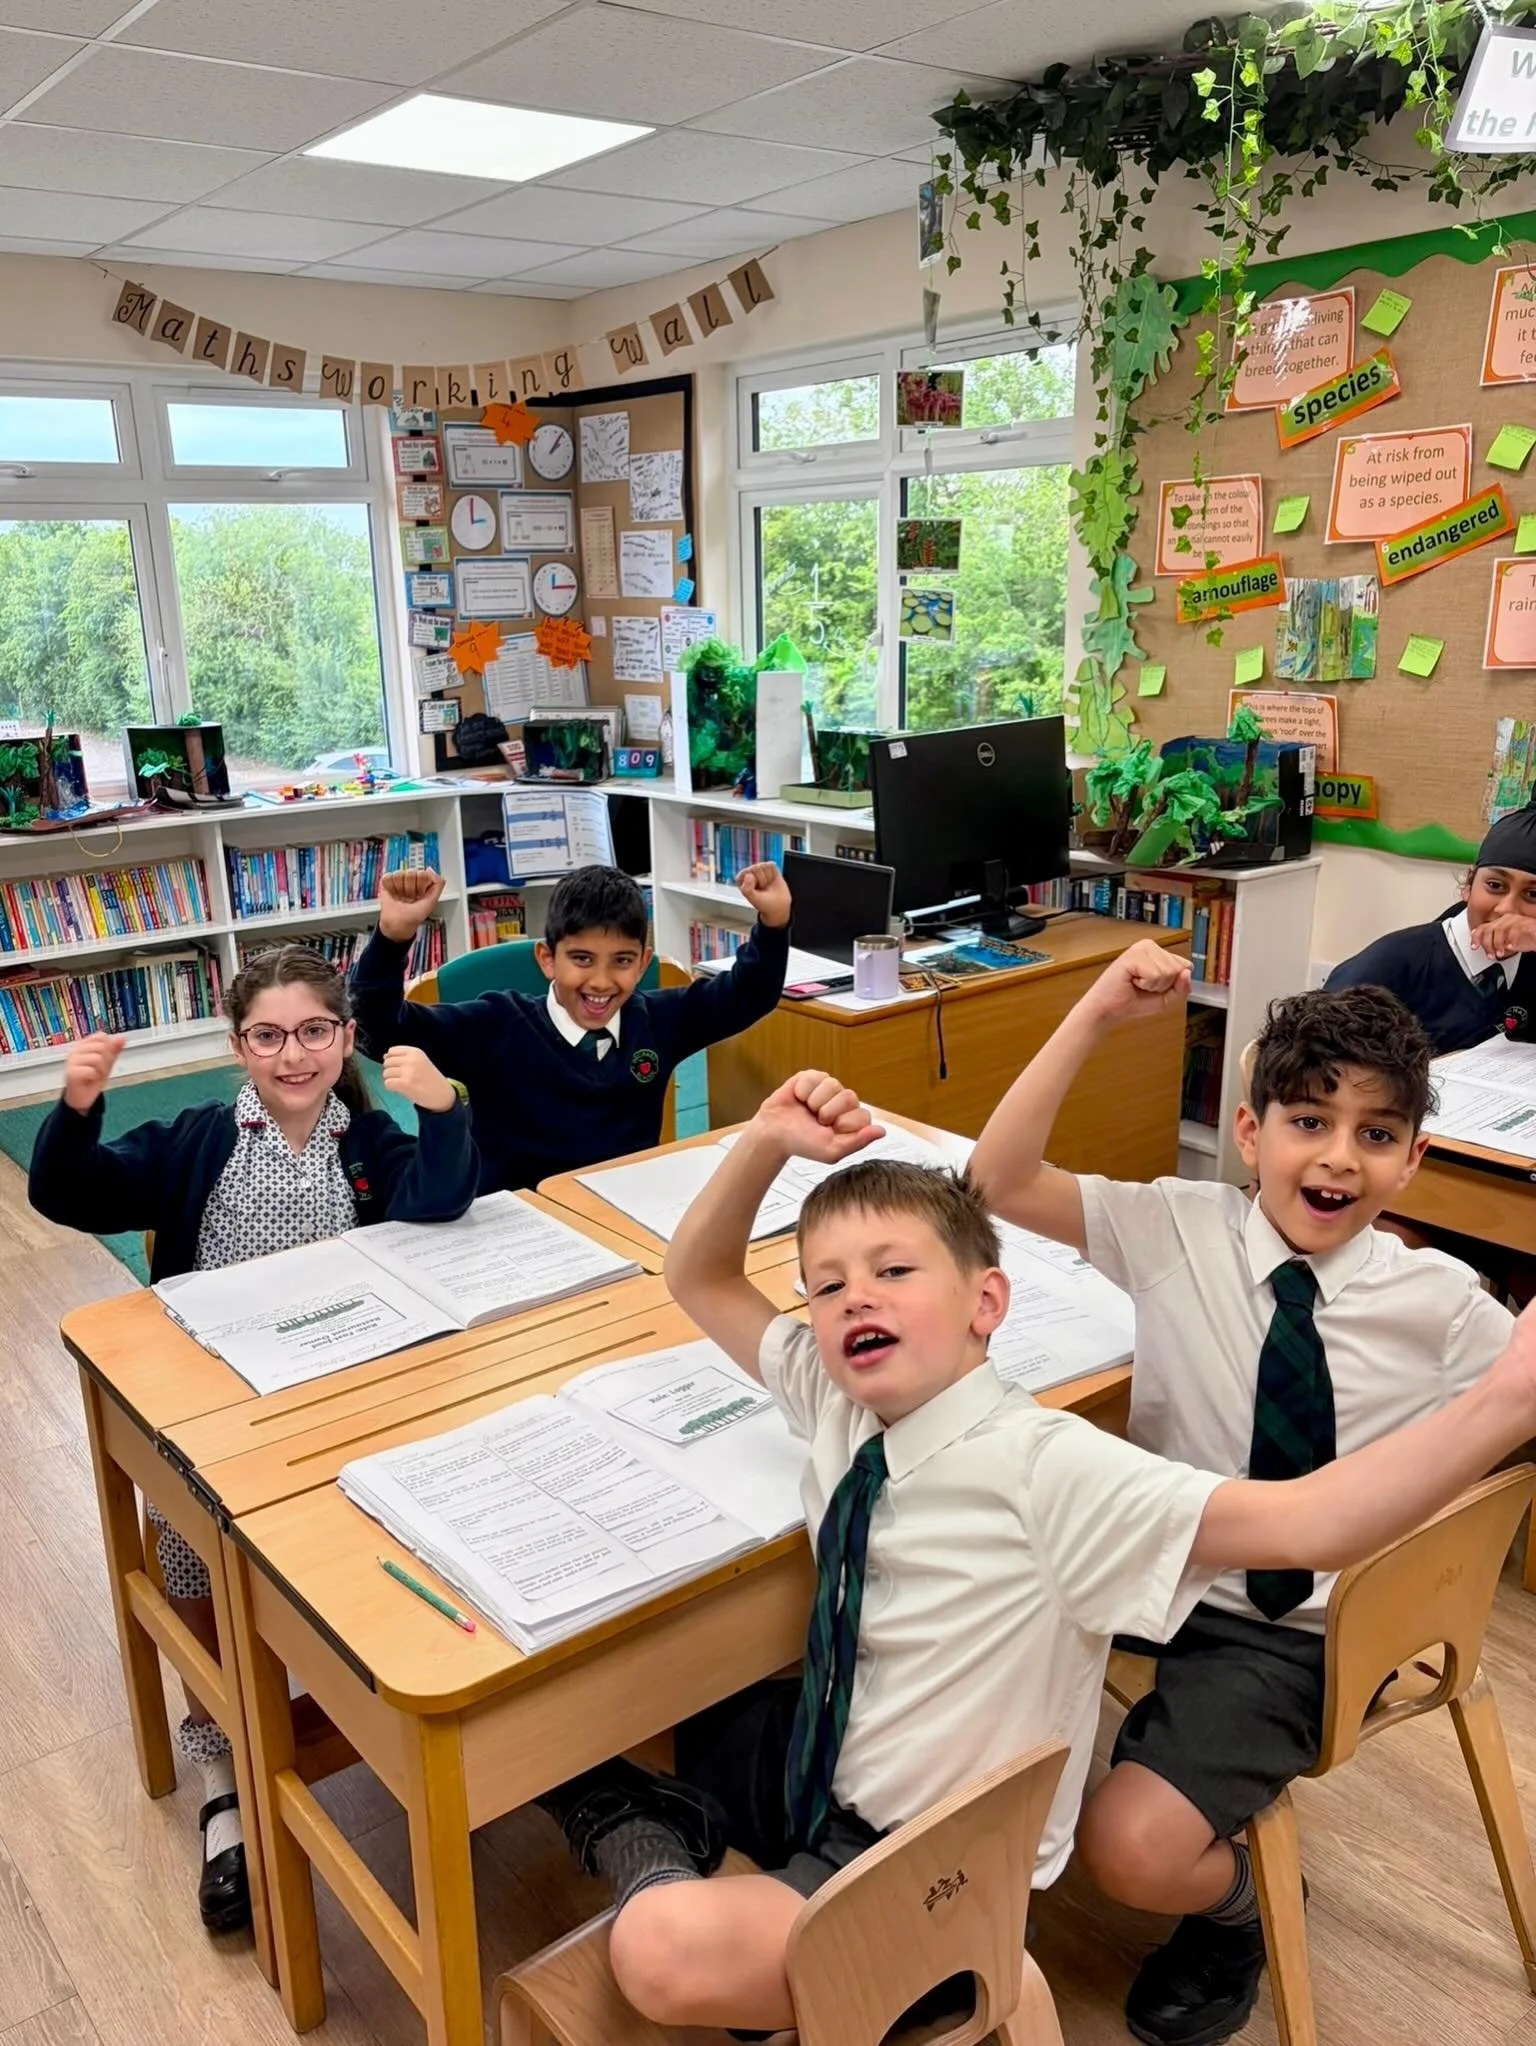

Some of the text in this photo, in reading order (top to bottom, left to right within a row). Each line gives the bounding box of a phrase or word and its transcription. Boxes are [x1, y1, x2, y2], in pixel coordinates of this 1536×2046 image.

[1466, 108, 1518, 137] the
[1313, 309, 1344, 325] living
[117, 293, 297, 382] Maths
[1251, 333, 1338, 358] thin that can
[1293, 364, 1382, 425] species
[1366, 446, 1445, 465] At risk from
[1349, 467, 1457, 489] being wiped out
[1359, 492, 1443, 509] as a species.
[1387, 498, 1500, 566] endangered
[1190, 572, 1278, 603] amouflage
[1314, 779, 1362, 806] nopy
